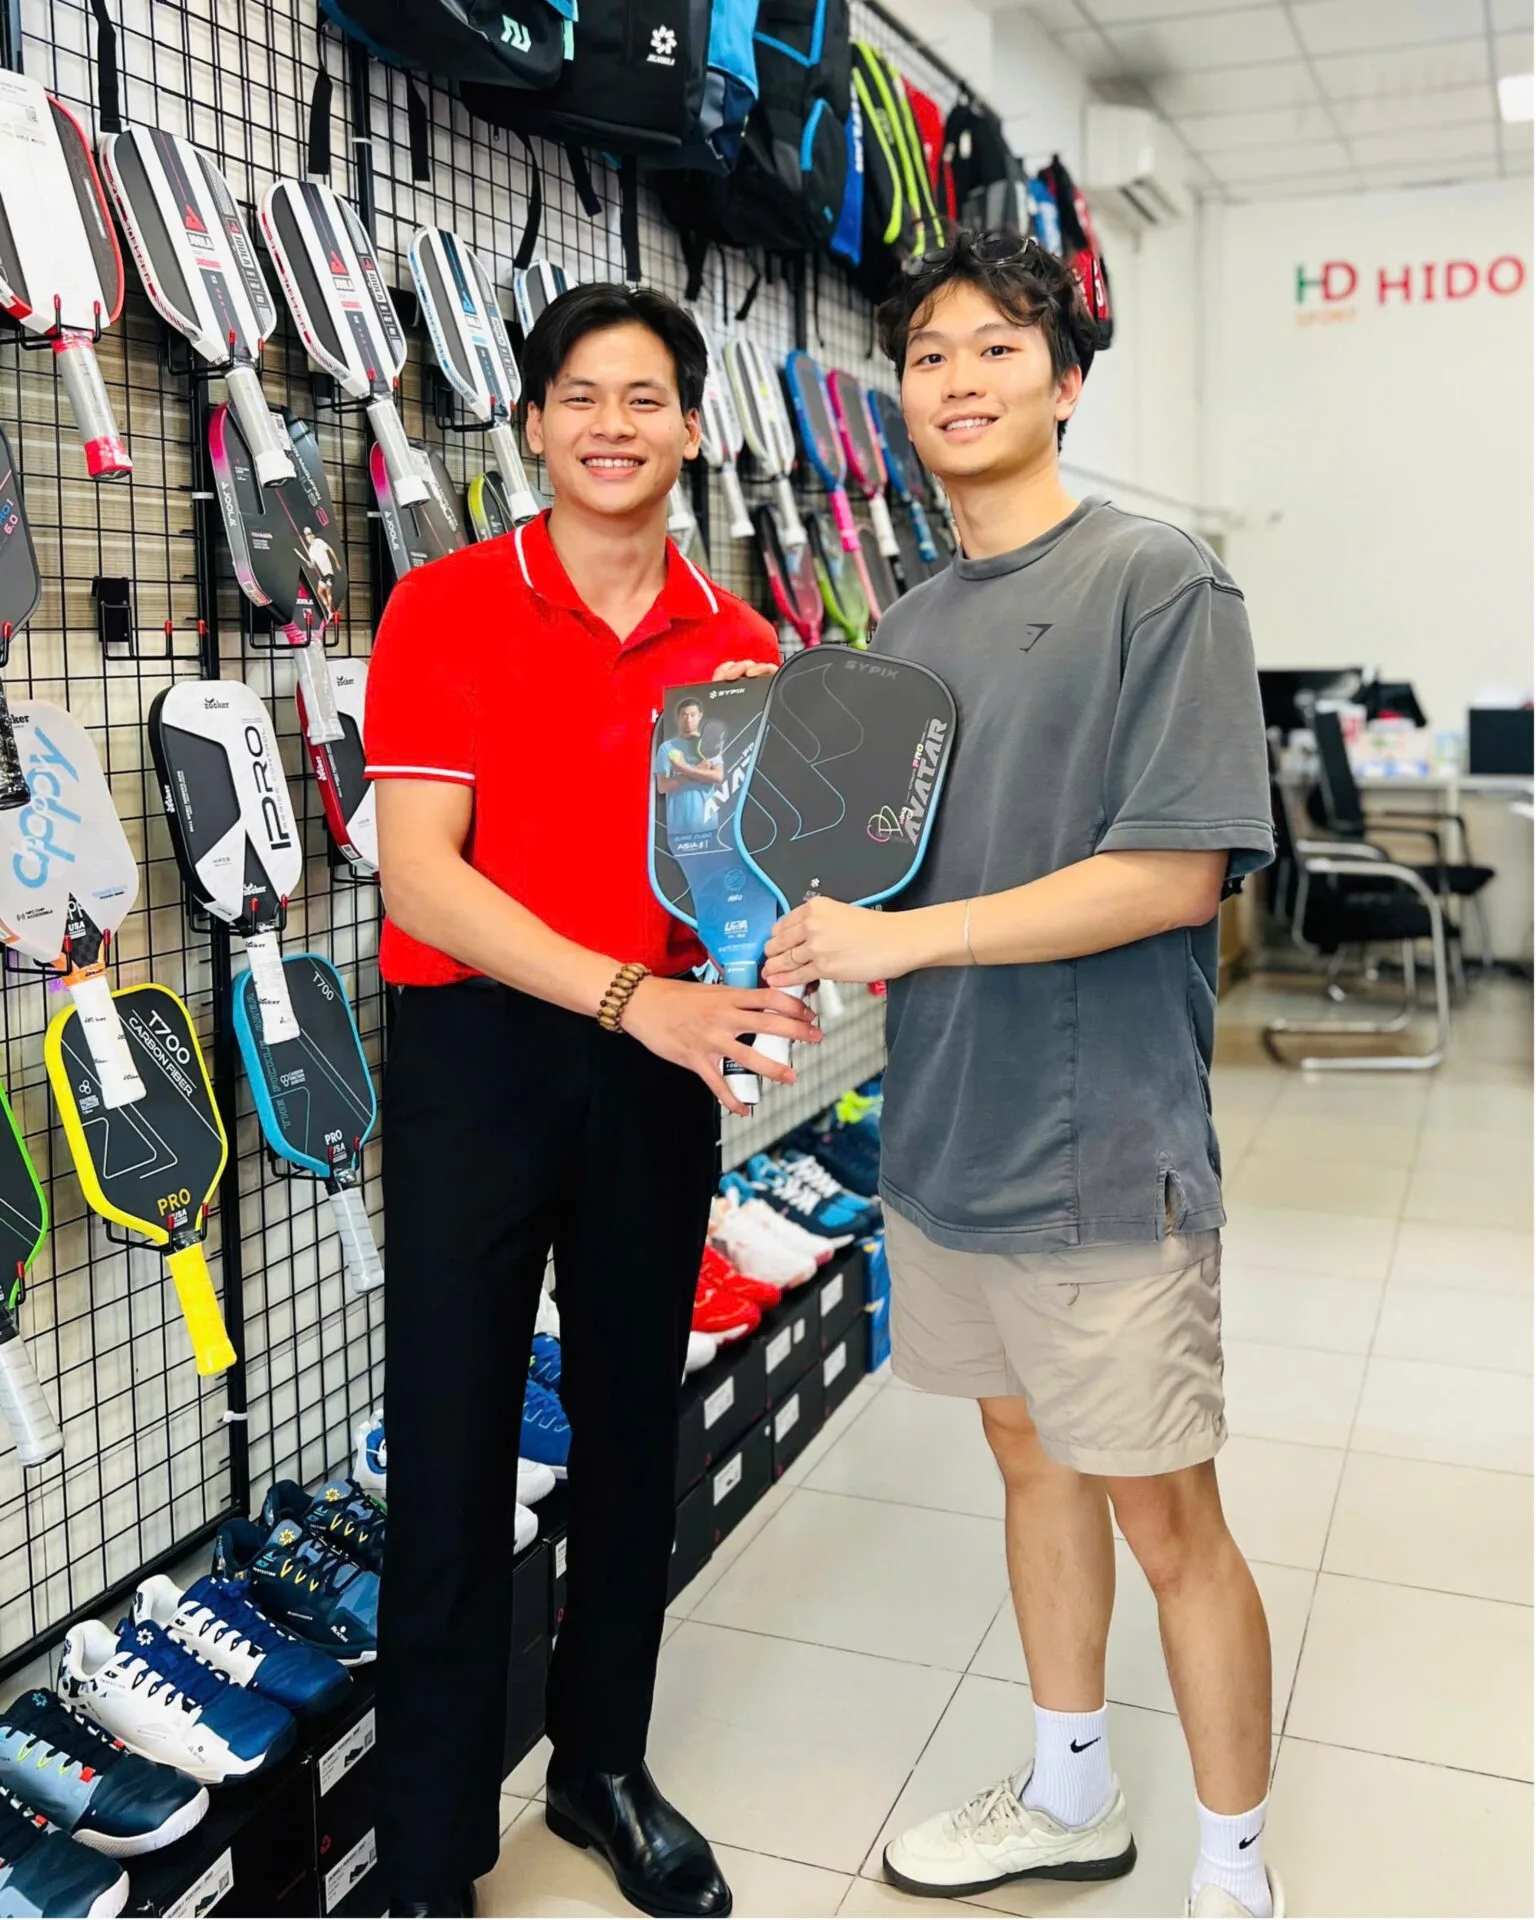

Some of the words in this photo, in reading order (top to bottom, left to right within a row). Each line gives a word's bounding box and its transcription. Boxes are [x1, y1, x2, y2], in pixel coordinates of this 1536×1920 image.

[1378, 256, 1526, 305] HIDO
[223, 490, 238, 527] JOOLA
[386, 518, 401, 551] JOOLA
[843, 660, 899, 680] SYPIK
[204, 700, 230, 710] zocker
[718, 688, 746, 698] SYPIK
[912, 743, 924, 769] PRO
[904, 718, 948, 847] AVATAR
[68, 921, 86, 932] USA
[312, 971, 335, 1001] T700
[148, 1009, 191, 1065] T700
[128, 1017, 169, 1066] CARBON
[165, 1063, 194, 1098] FIBER
[324, 1128, 343, 1146] PRO
[157, 1188, 191, 1217] PRO
